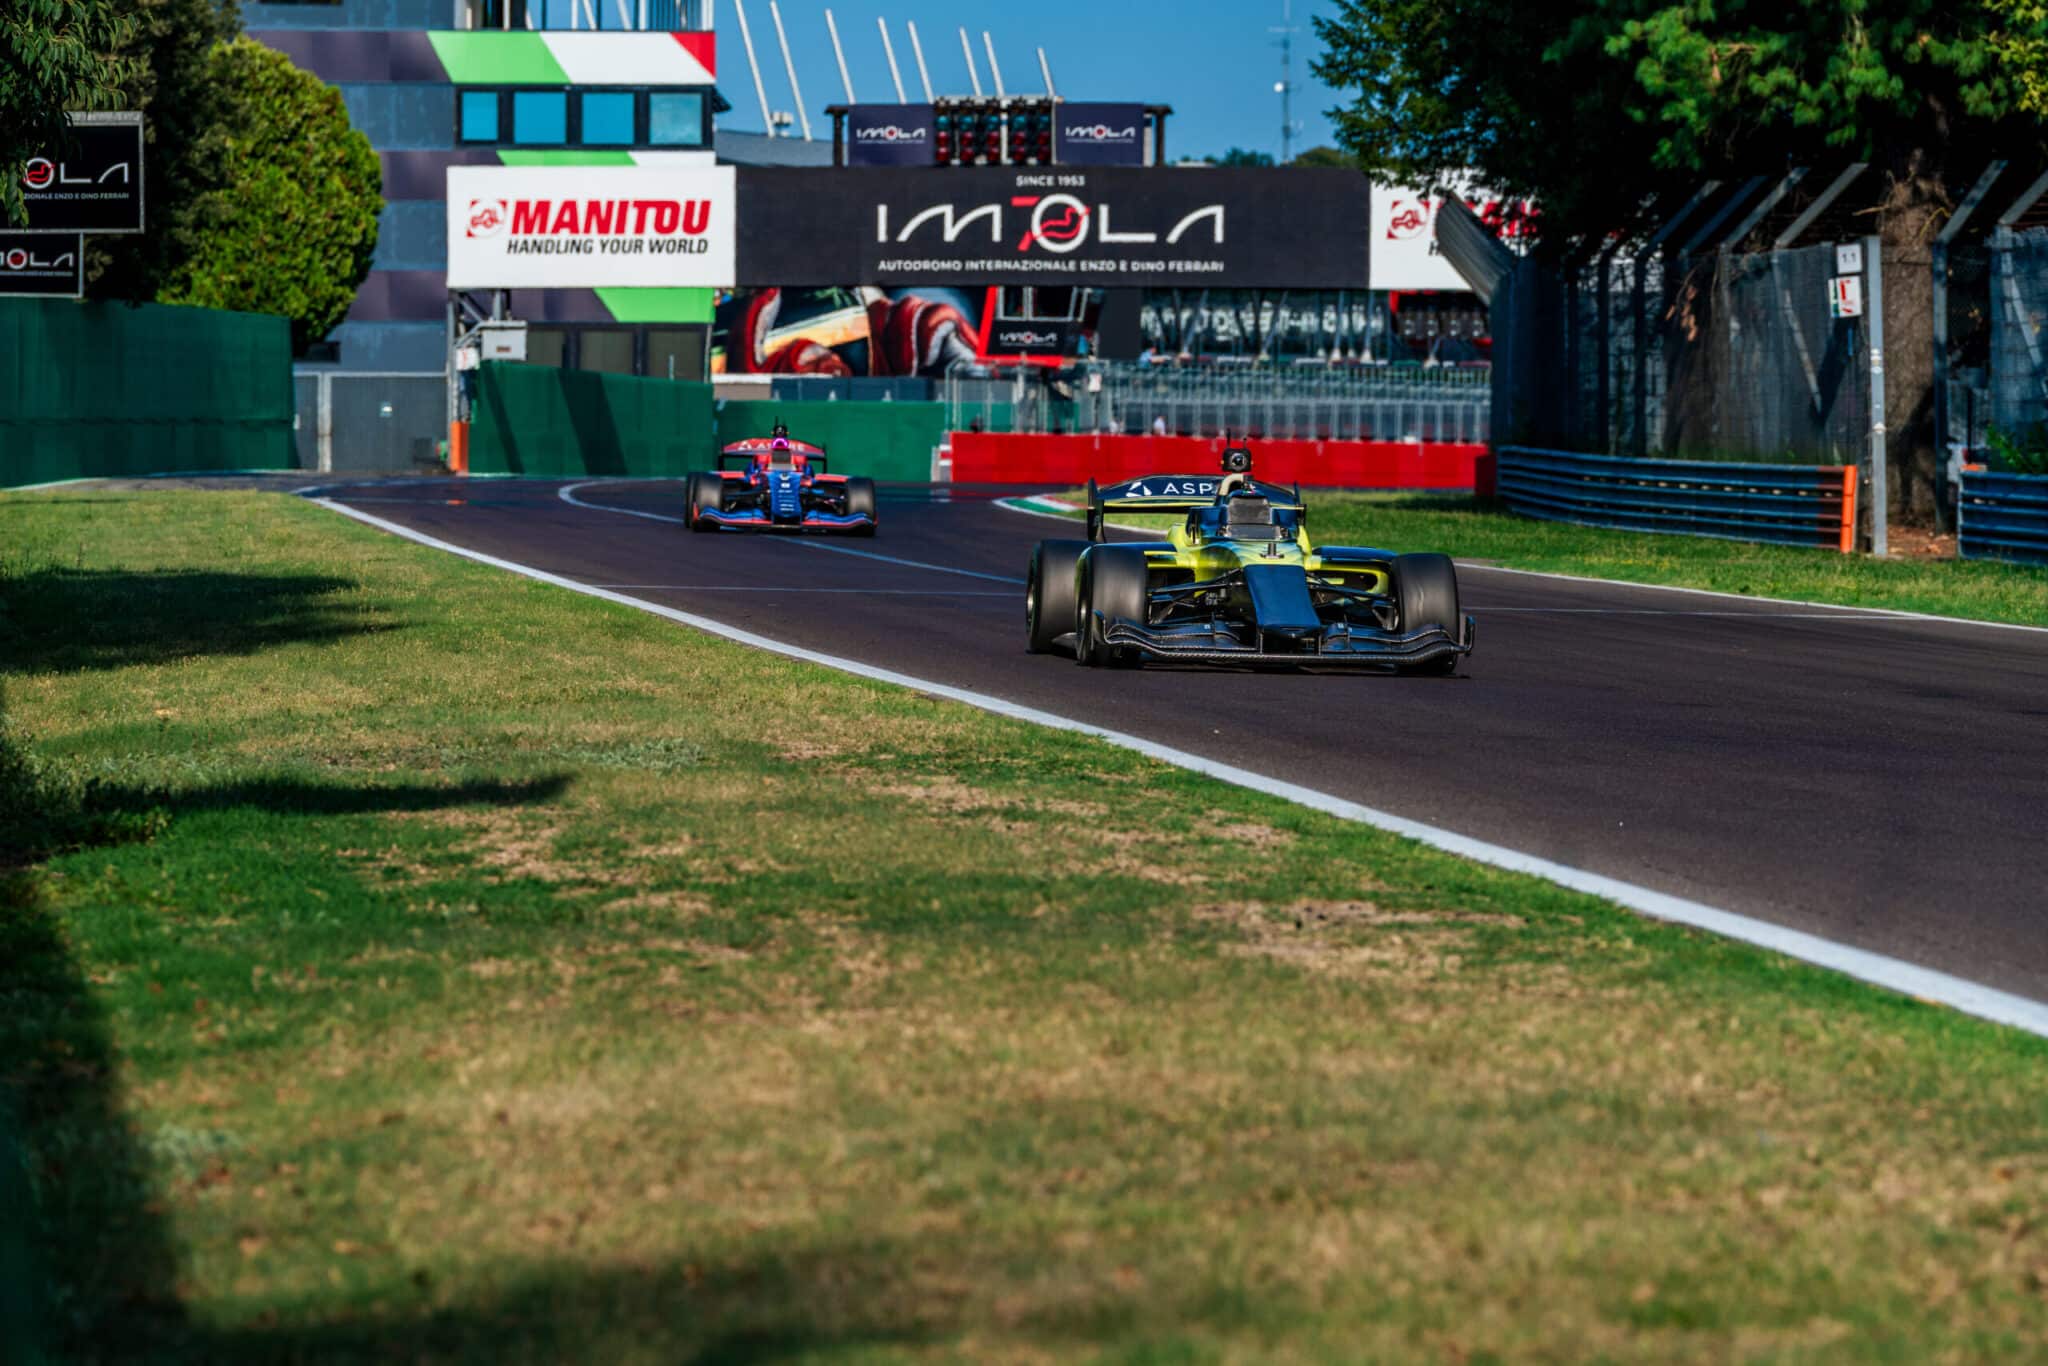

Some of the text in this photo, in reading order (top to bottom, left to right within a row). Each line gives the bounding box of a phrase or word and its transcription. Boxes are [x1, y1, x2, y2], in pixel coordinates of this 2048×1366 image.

[856, 125, 926, 140] IMOLA
[1065, 124, 1135, 138] IMOLA
[25, 157, 129, 190] OLA
[1016, 175, 1086, 186] SINCE 1953
[511, 200, 711, 235] MANITOU
[877, 193, 1224, 253] IMOLA
[507, 239, 708, 253] HANDLING YOUR WORLD
[0, 248, 74, 270] OLA
[878, 260, 1224, 272] AUTODROMO INTERNAZIONALE ENZO E DINO FERRARI
[1163, 483, 1217, 494] ASP
